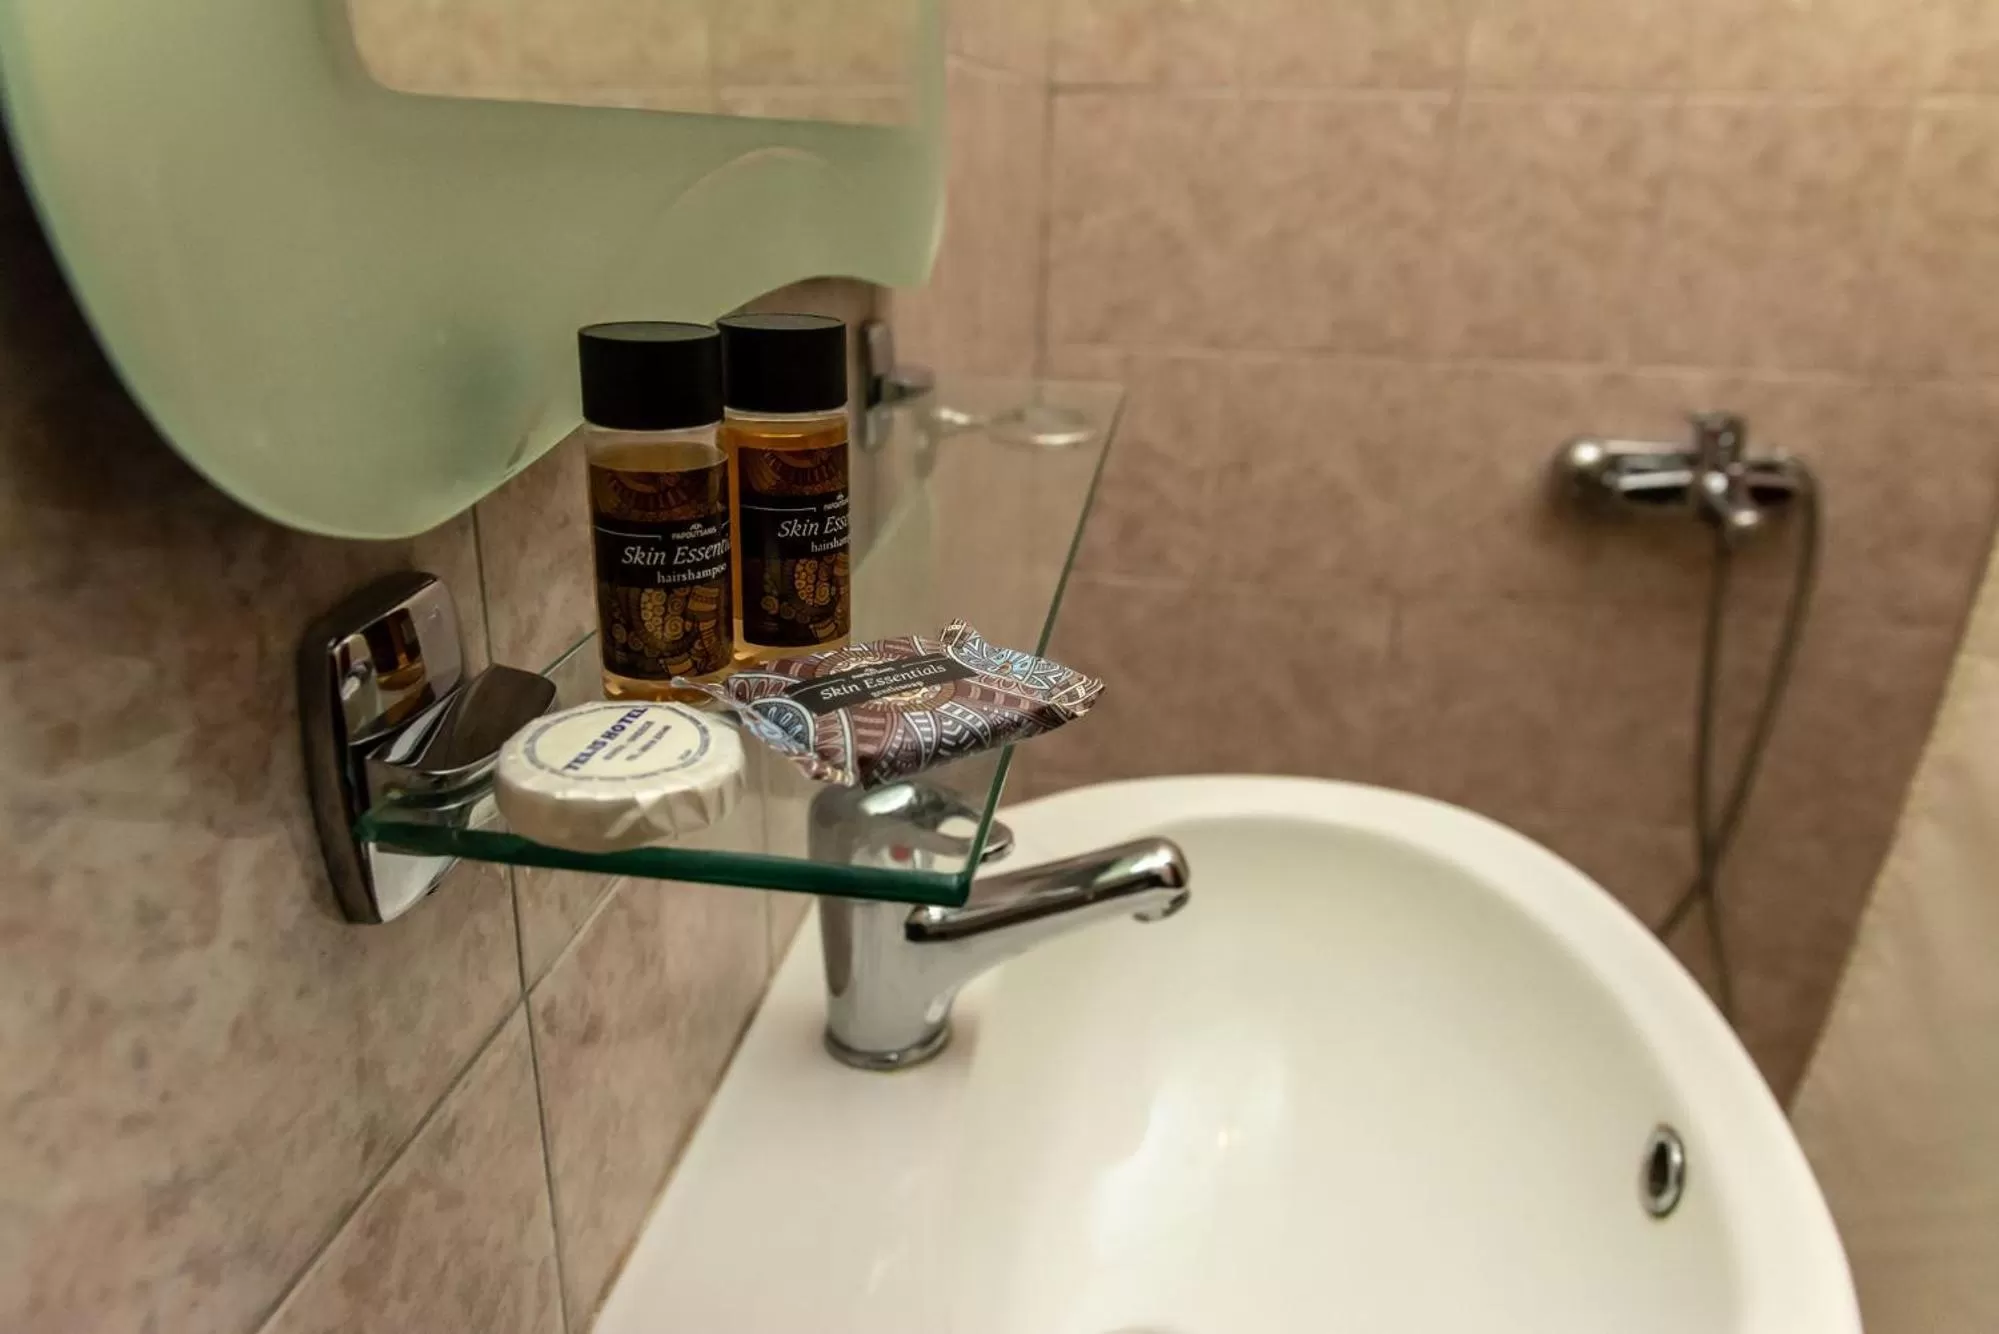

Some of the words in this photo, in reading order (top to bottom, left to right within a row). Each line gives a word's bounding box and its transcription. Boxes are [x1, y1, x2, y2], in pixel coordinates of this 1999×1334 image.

[777, 518, 819, 538] Skin
[621, 545, 667, 566] Skin
[820, 683, 862, 700] Skin
[863, 664, 947, 689] Essentials
[601, 707, 649, 741] HOTEL
